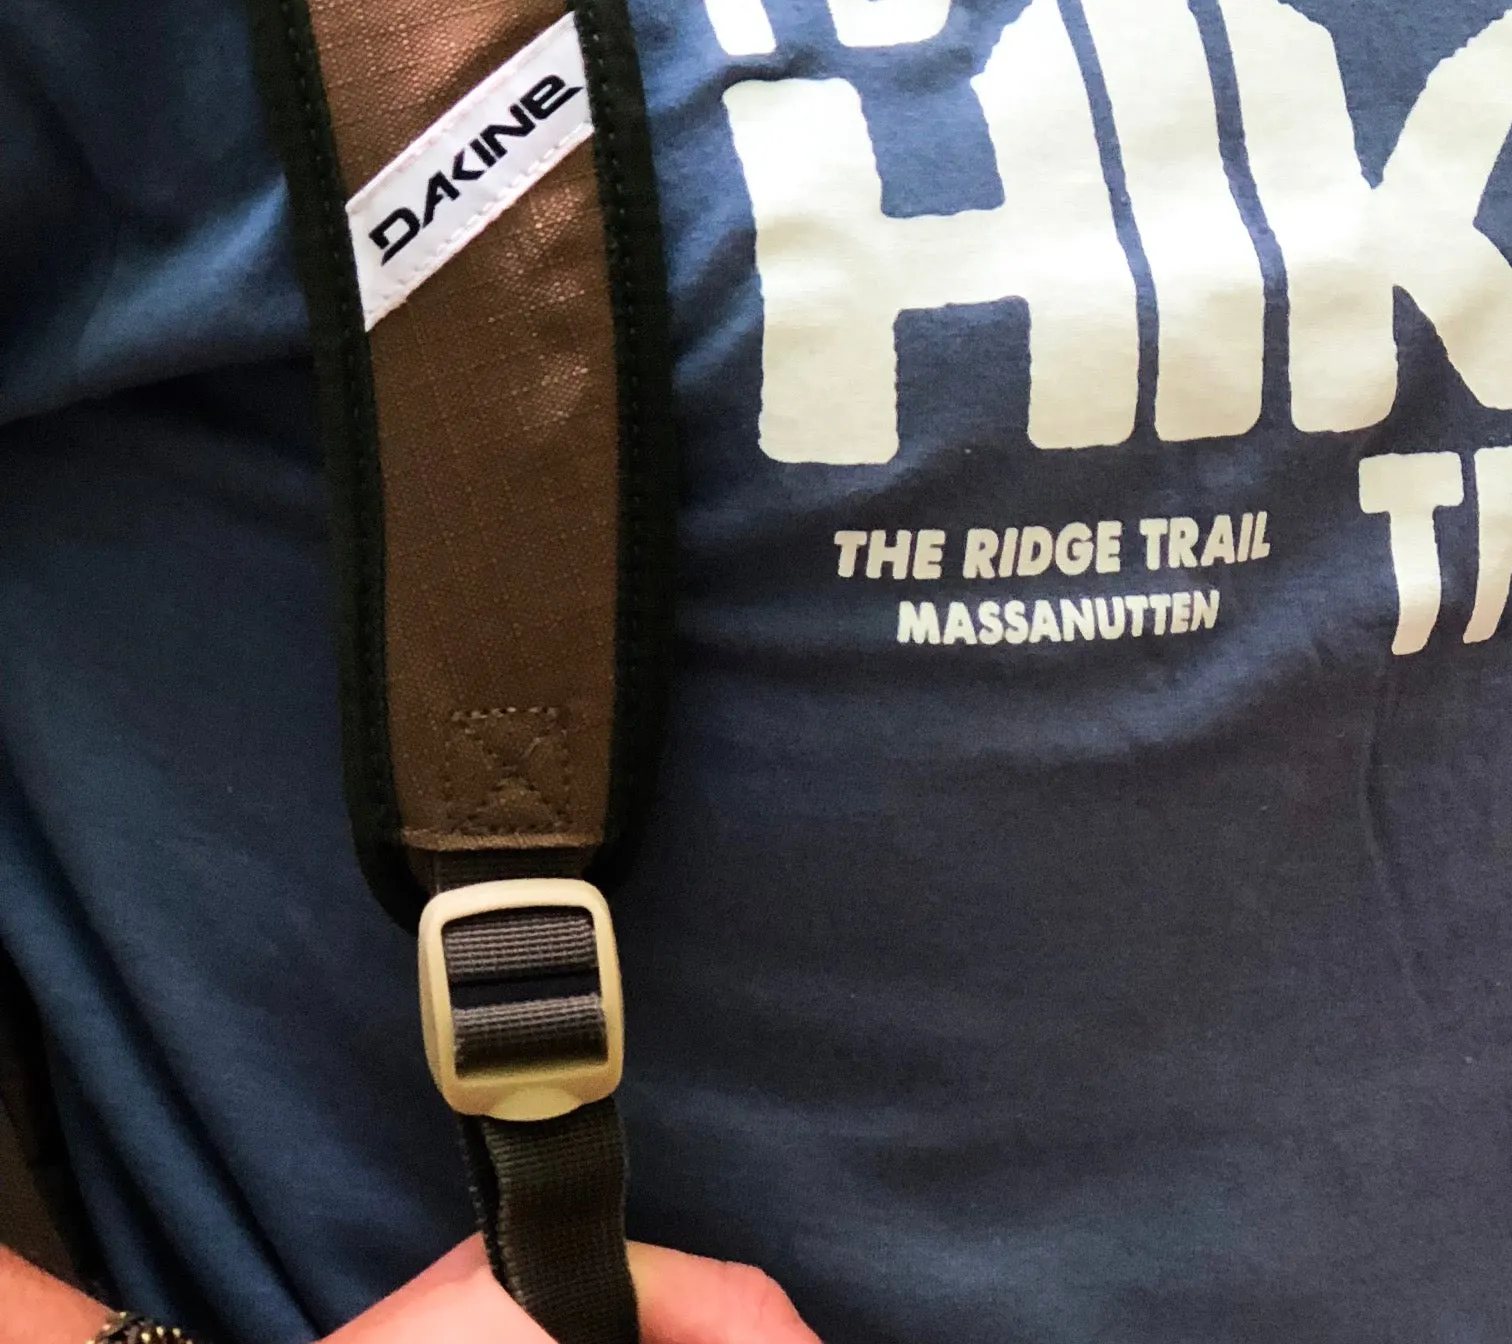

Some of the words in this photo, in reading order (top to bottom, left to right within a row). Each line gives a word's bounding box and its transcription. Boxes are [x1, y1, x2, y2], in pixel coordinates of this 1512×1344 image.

[368, 74, 584, 266] DAKINE
[834, 529, 946, 580] THE
[963, 520, 1122, 579] RIDGE
[1139, 511, 1271, 571] TRAIL
[897, 589, 1220, 645] MASSANUTTEN
